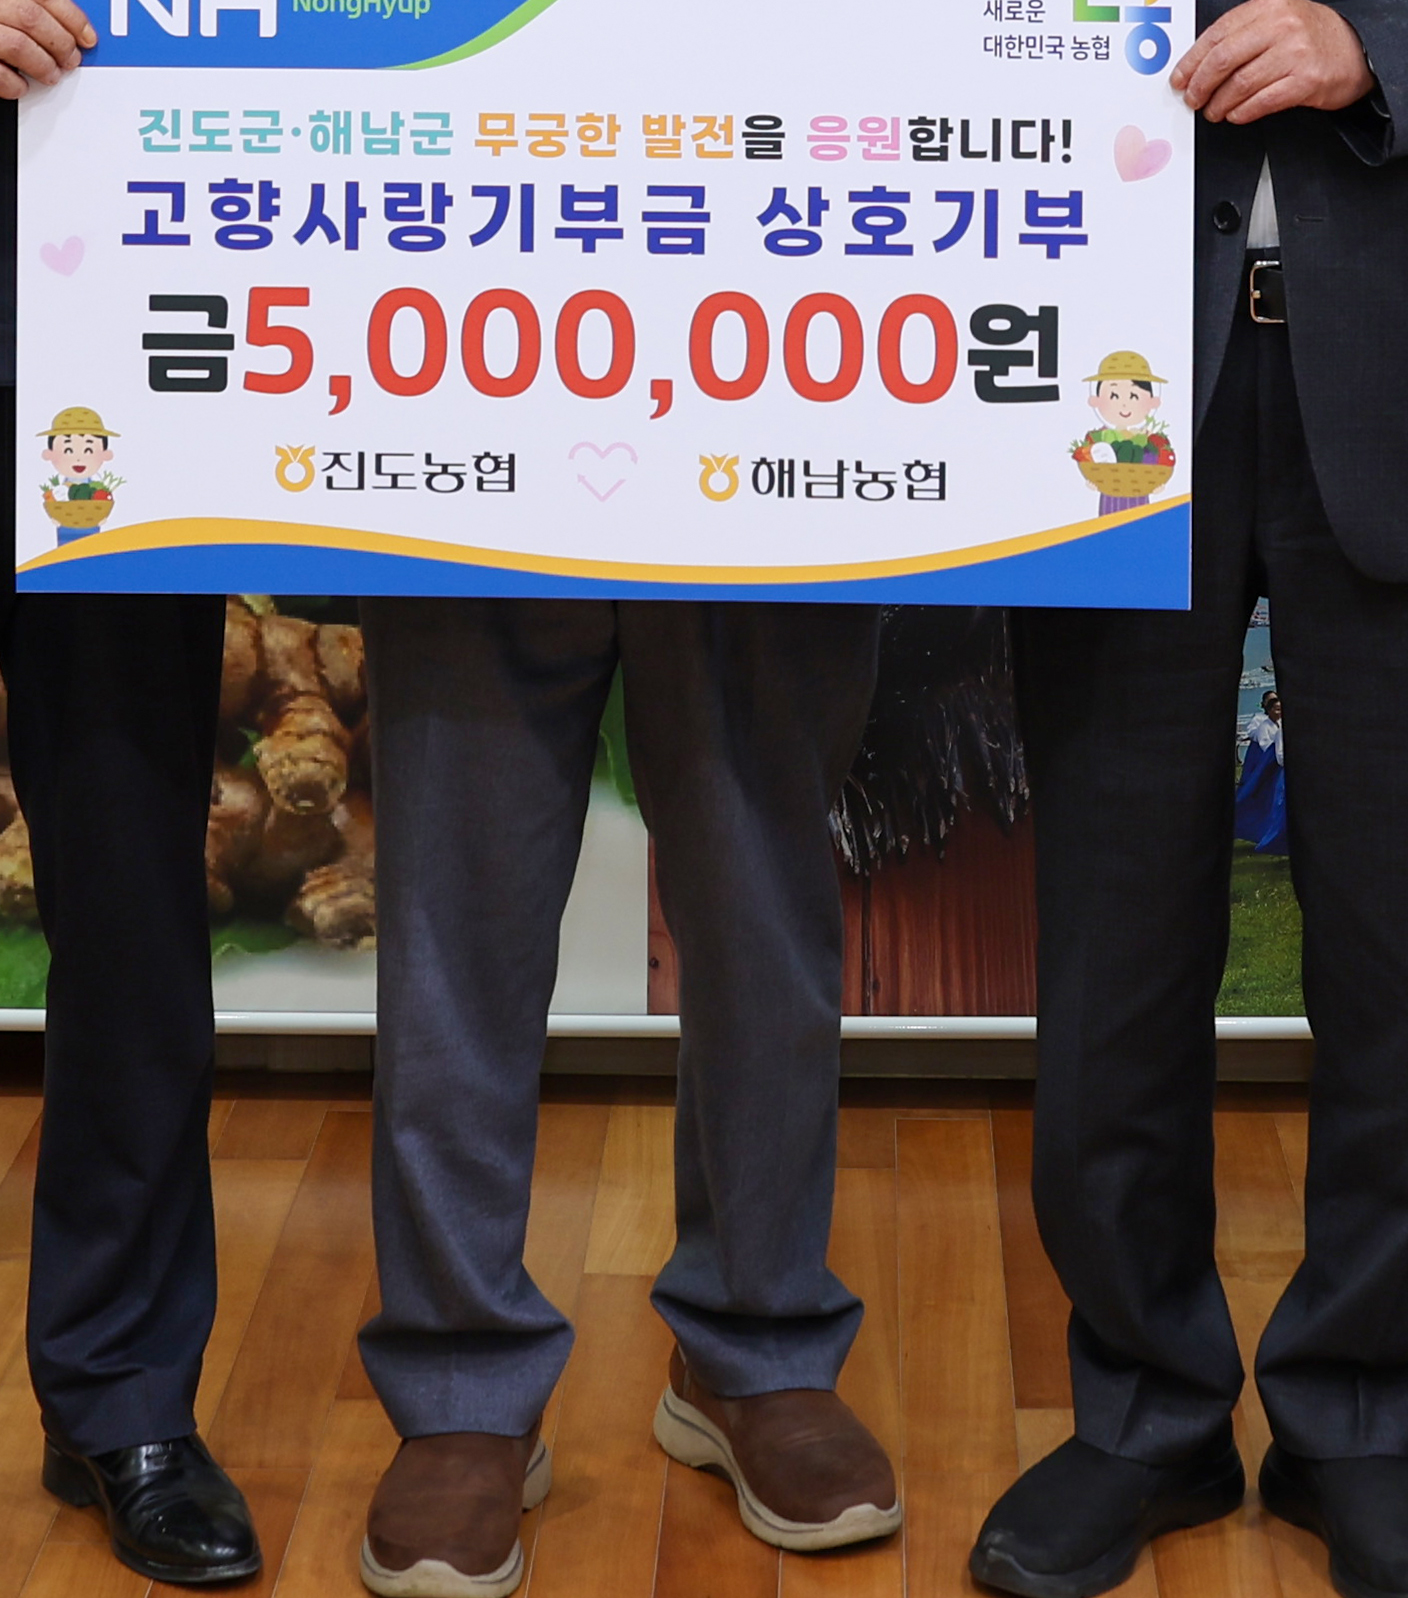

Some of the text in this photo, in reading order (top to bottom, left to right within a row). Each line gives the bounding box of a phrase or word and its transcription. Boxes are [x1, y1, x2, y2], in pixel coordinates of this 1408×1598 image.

[983, 0, 1046, 23] 새로운
[983, 34, 1110, 61] 대한민국 농협
[474, 112, 621, 158] 무궁한
[642, 114, 786, 161] 발전을
[806, 114, 1073, 164] 응원합니다!
[122, 177, 1088, 260] 고향사랑기부금 상호기부
[141, 285, 1061, 419] 금5,000,000원
[320, 450, 948, 502] 진도농협 해남농협
